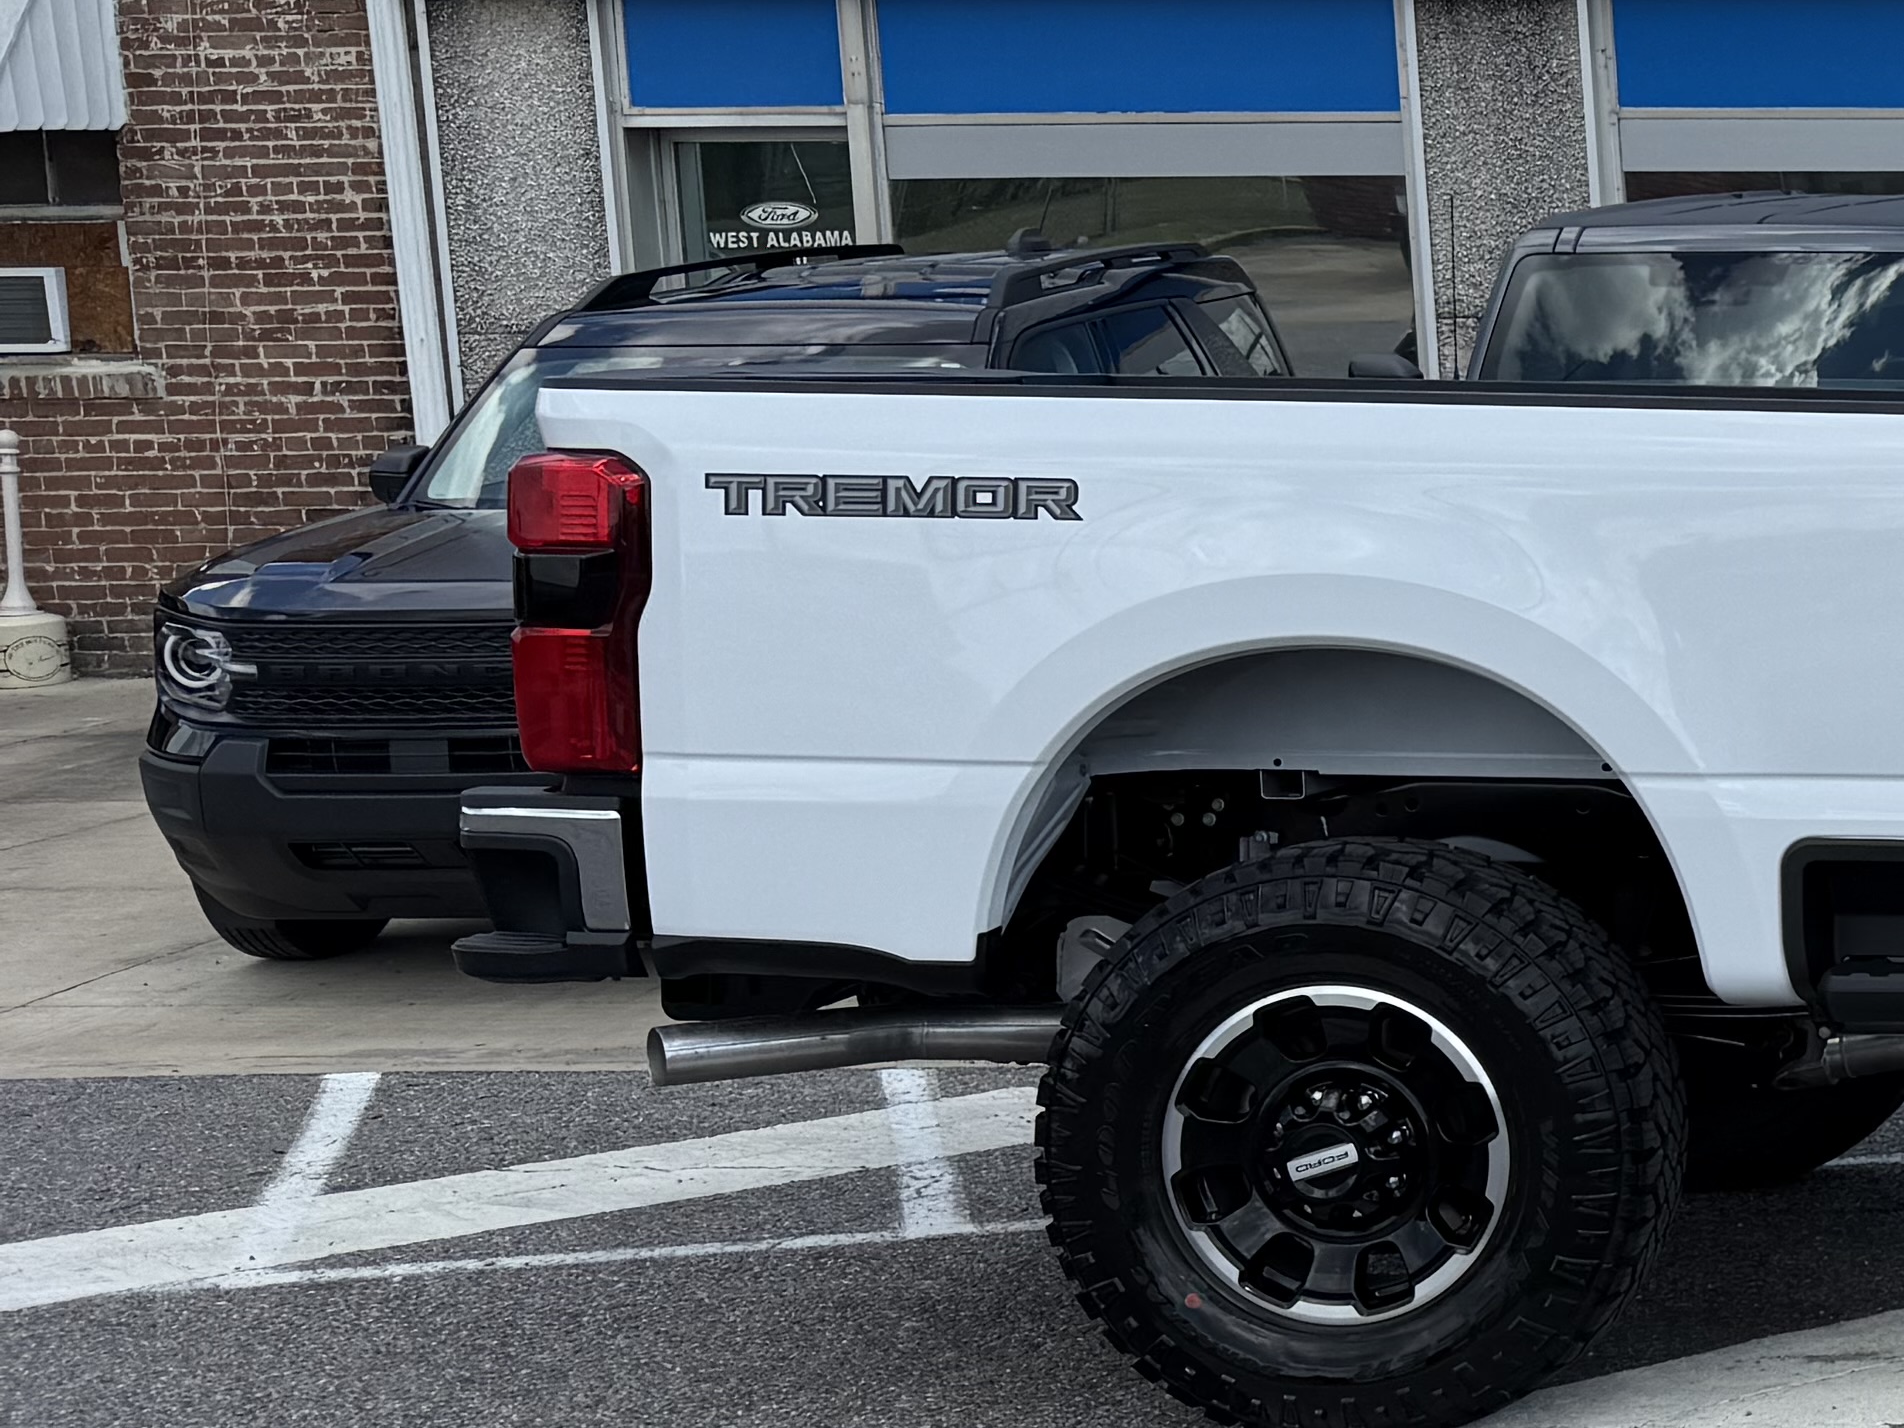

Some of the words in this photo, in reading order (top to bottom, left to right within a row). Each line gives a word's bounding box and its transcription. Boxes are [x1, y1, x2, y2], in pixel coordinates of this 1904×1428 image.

[758, 206, 799, 221] Ford
[710, 232, 759, 248] WEST
[767, 230, 853, 248] ALABAMA
[705, 473, 1083, 521] TREMOR
[1295, 1151, 1349, 1172] FORD
